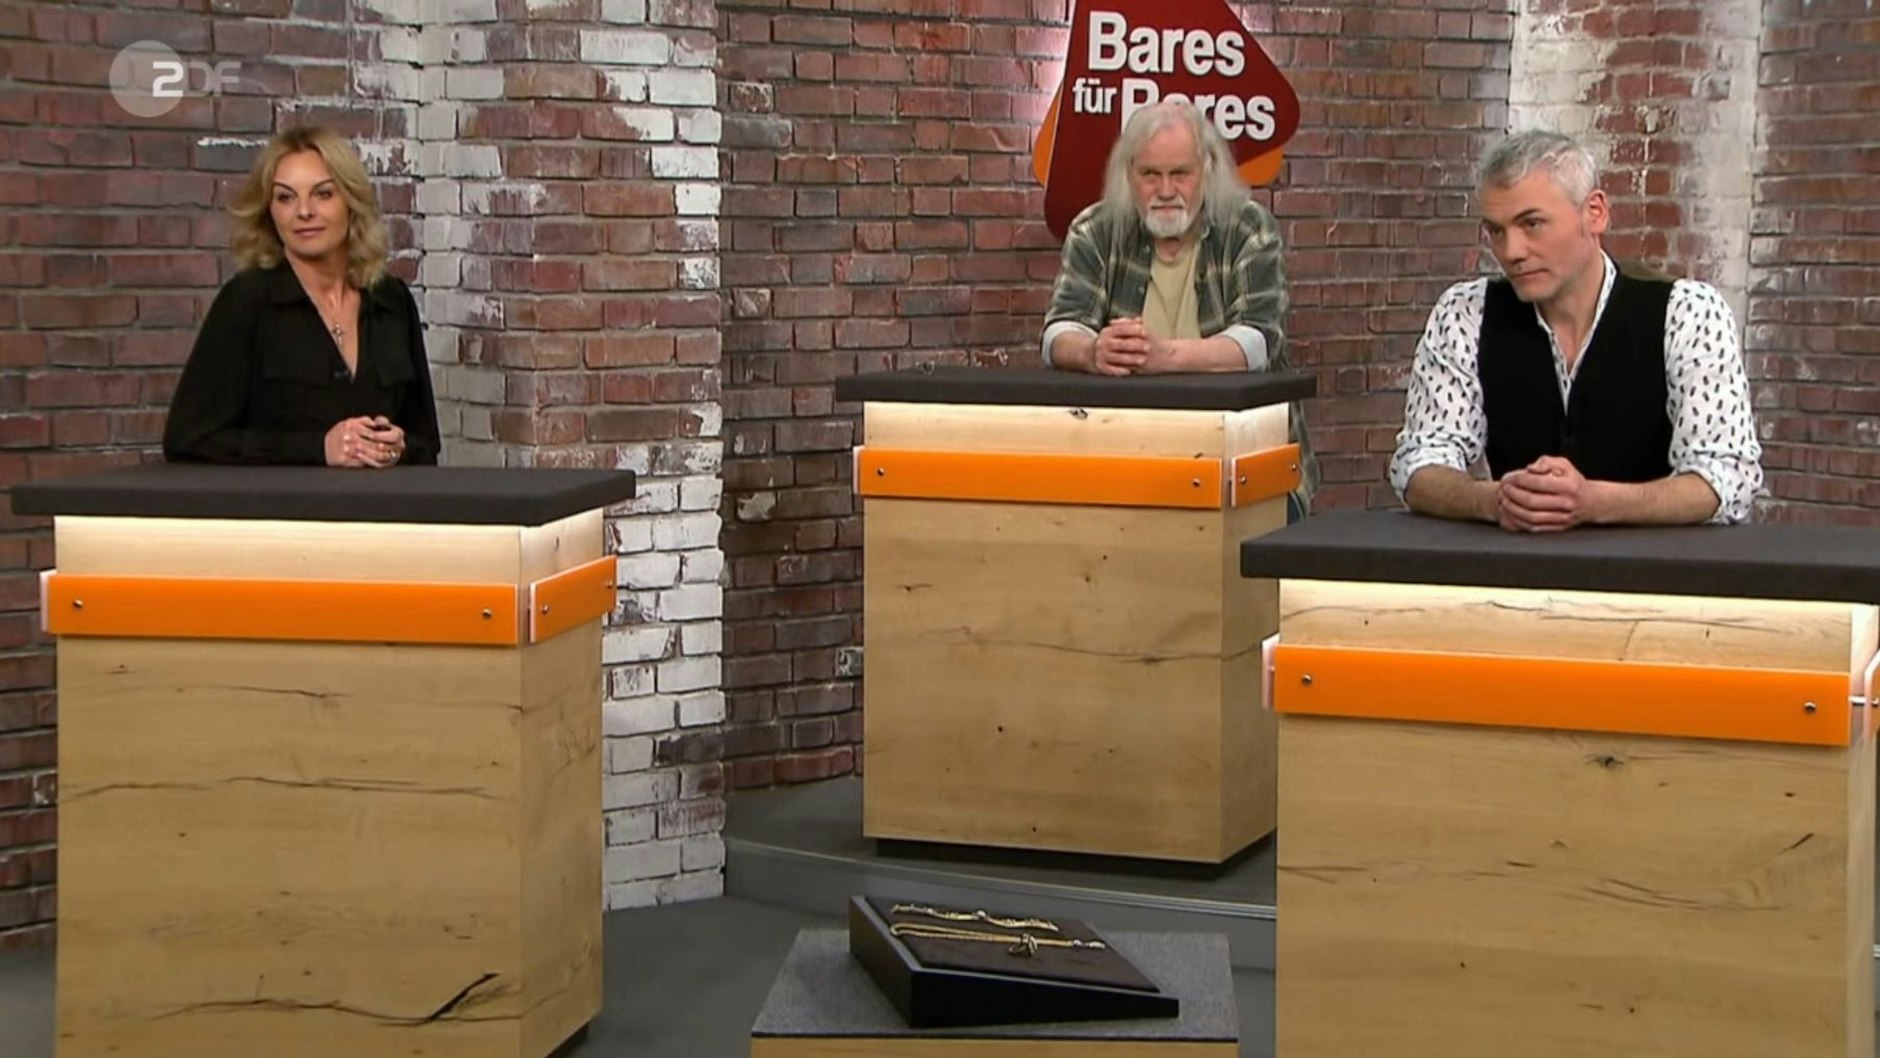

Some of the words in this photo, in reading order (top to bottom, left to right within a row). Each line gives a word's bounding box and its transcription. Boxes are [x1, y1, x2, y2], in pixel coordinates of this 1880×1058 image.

[1088, 10, 1245, 76] Bares
[1073, 77, 1117, 113] für
[1121, 77, 1275, 140] Rres
